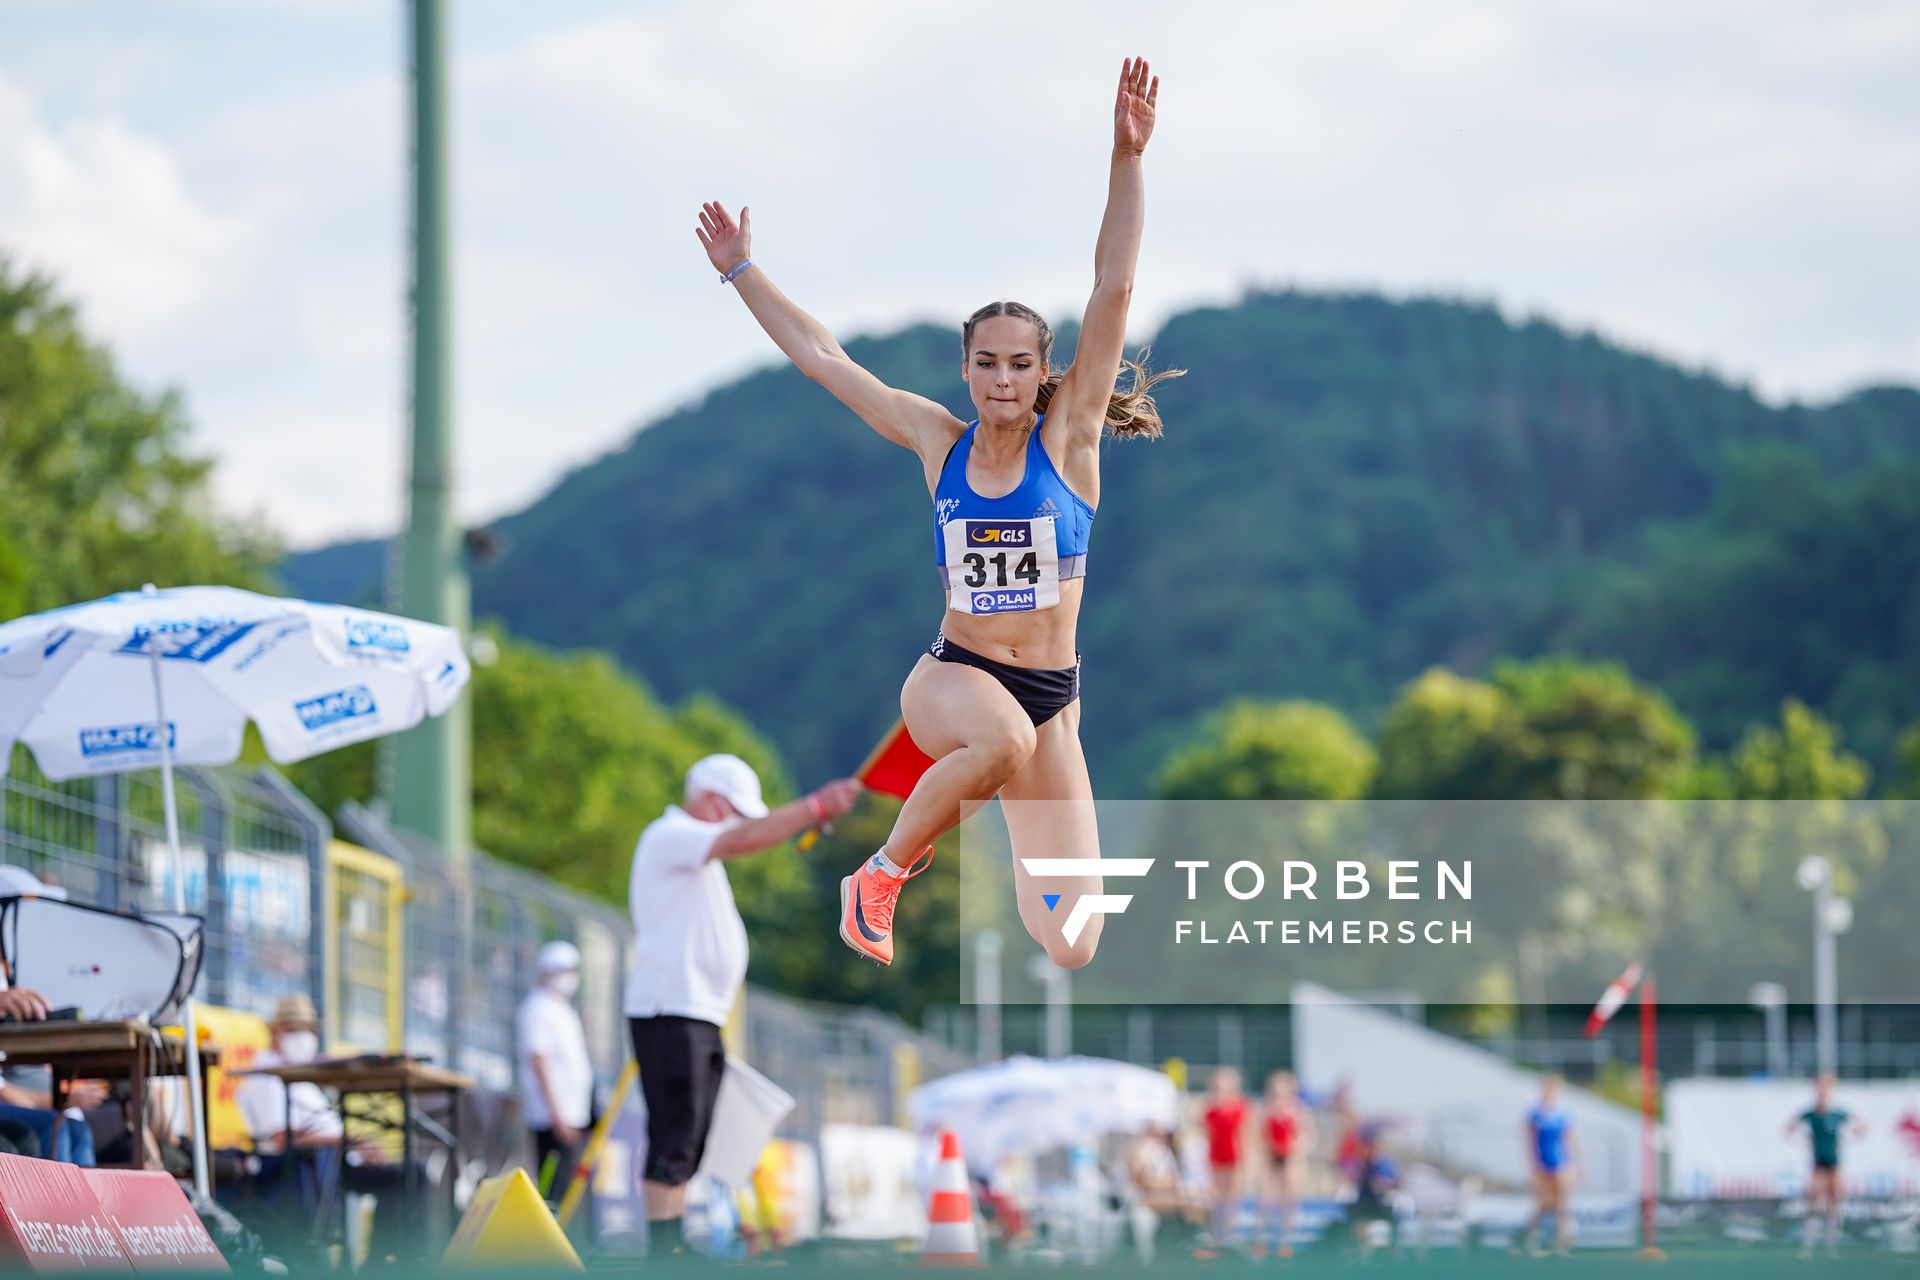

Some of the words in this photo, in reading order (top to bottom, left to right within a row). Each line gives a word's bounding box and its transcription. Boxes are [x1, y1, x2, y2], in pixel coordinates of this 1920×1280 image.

[1032, 509, 1062, 519] adidas
[1000, 529, 1026, 543] GLS
[963, 552, 1041, 588] 314
[997, 593, 1033, 605] PLAN
[9, 1207, 122, 1267] benz-sport.de
[112, 1214, 214, 1265] benz-sport.de
